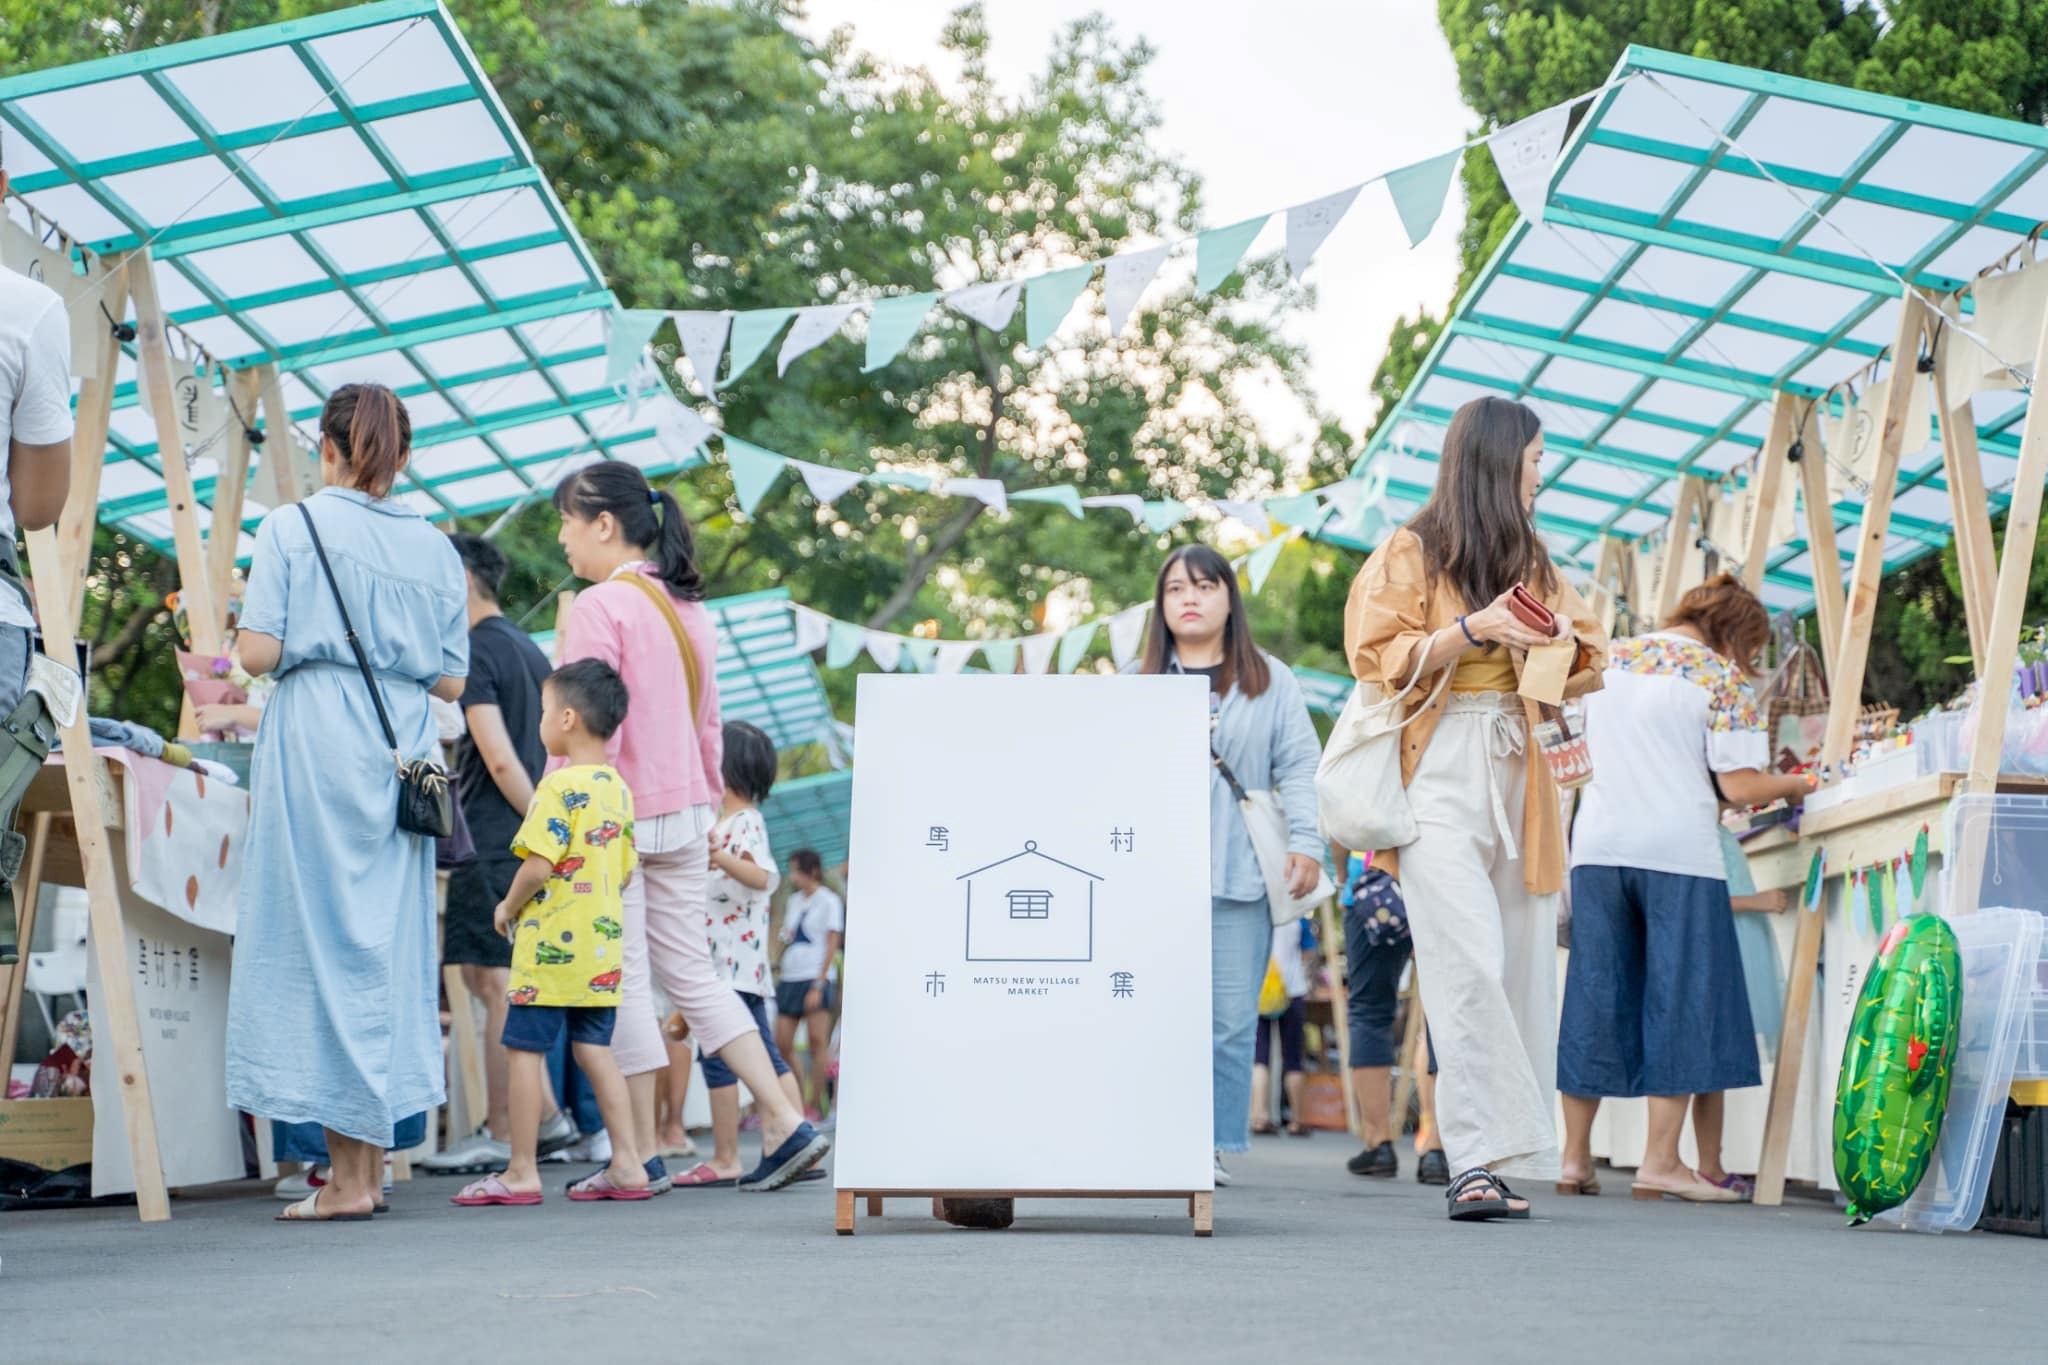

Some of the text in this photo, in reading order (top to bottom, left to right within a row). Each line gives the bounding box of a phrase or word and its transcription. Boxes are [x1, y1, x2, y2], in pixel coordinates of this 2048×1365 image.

[925, 826, 1135, 852] 馬 村
[925, 970, 1135, 998] 市 集
[973, 977, 1081, 985] MATSU NEW VILLAGE
[1007, 987, 1049, 996] MARKET
